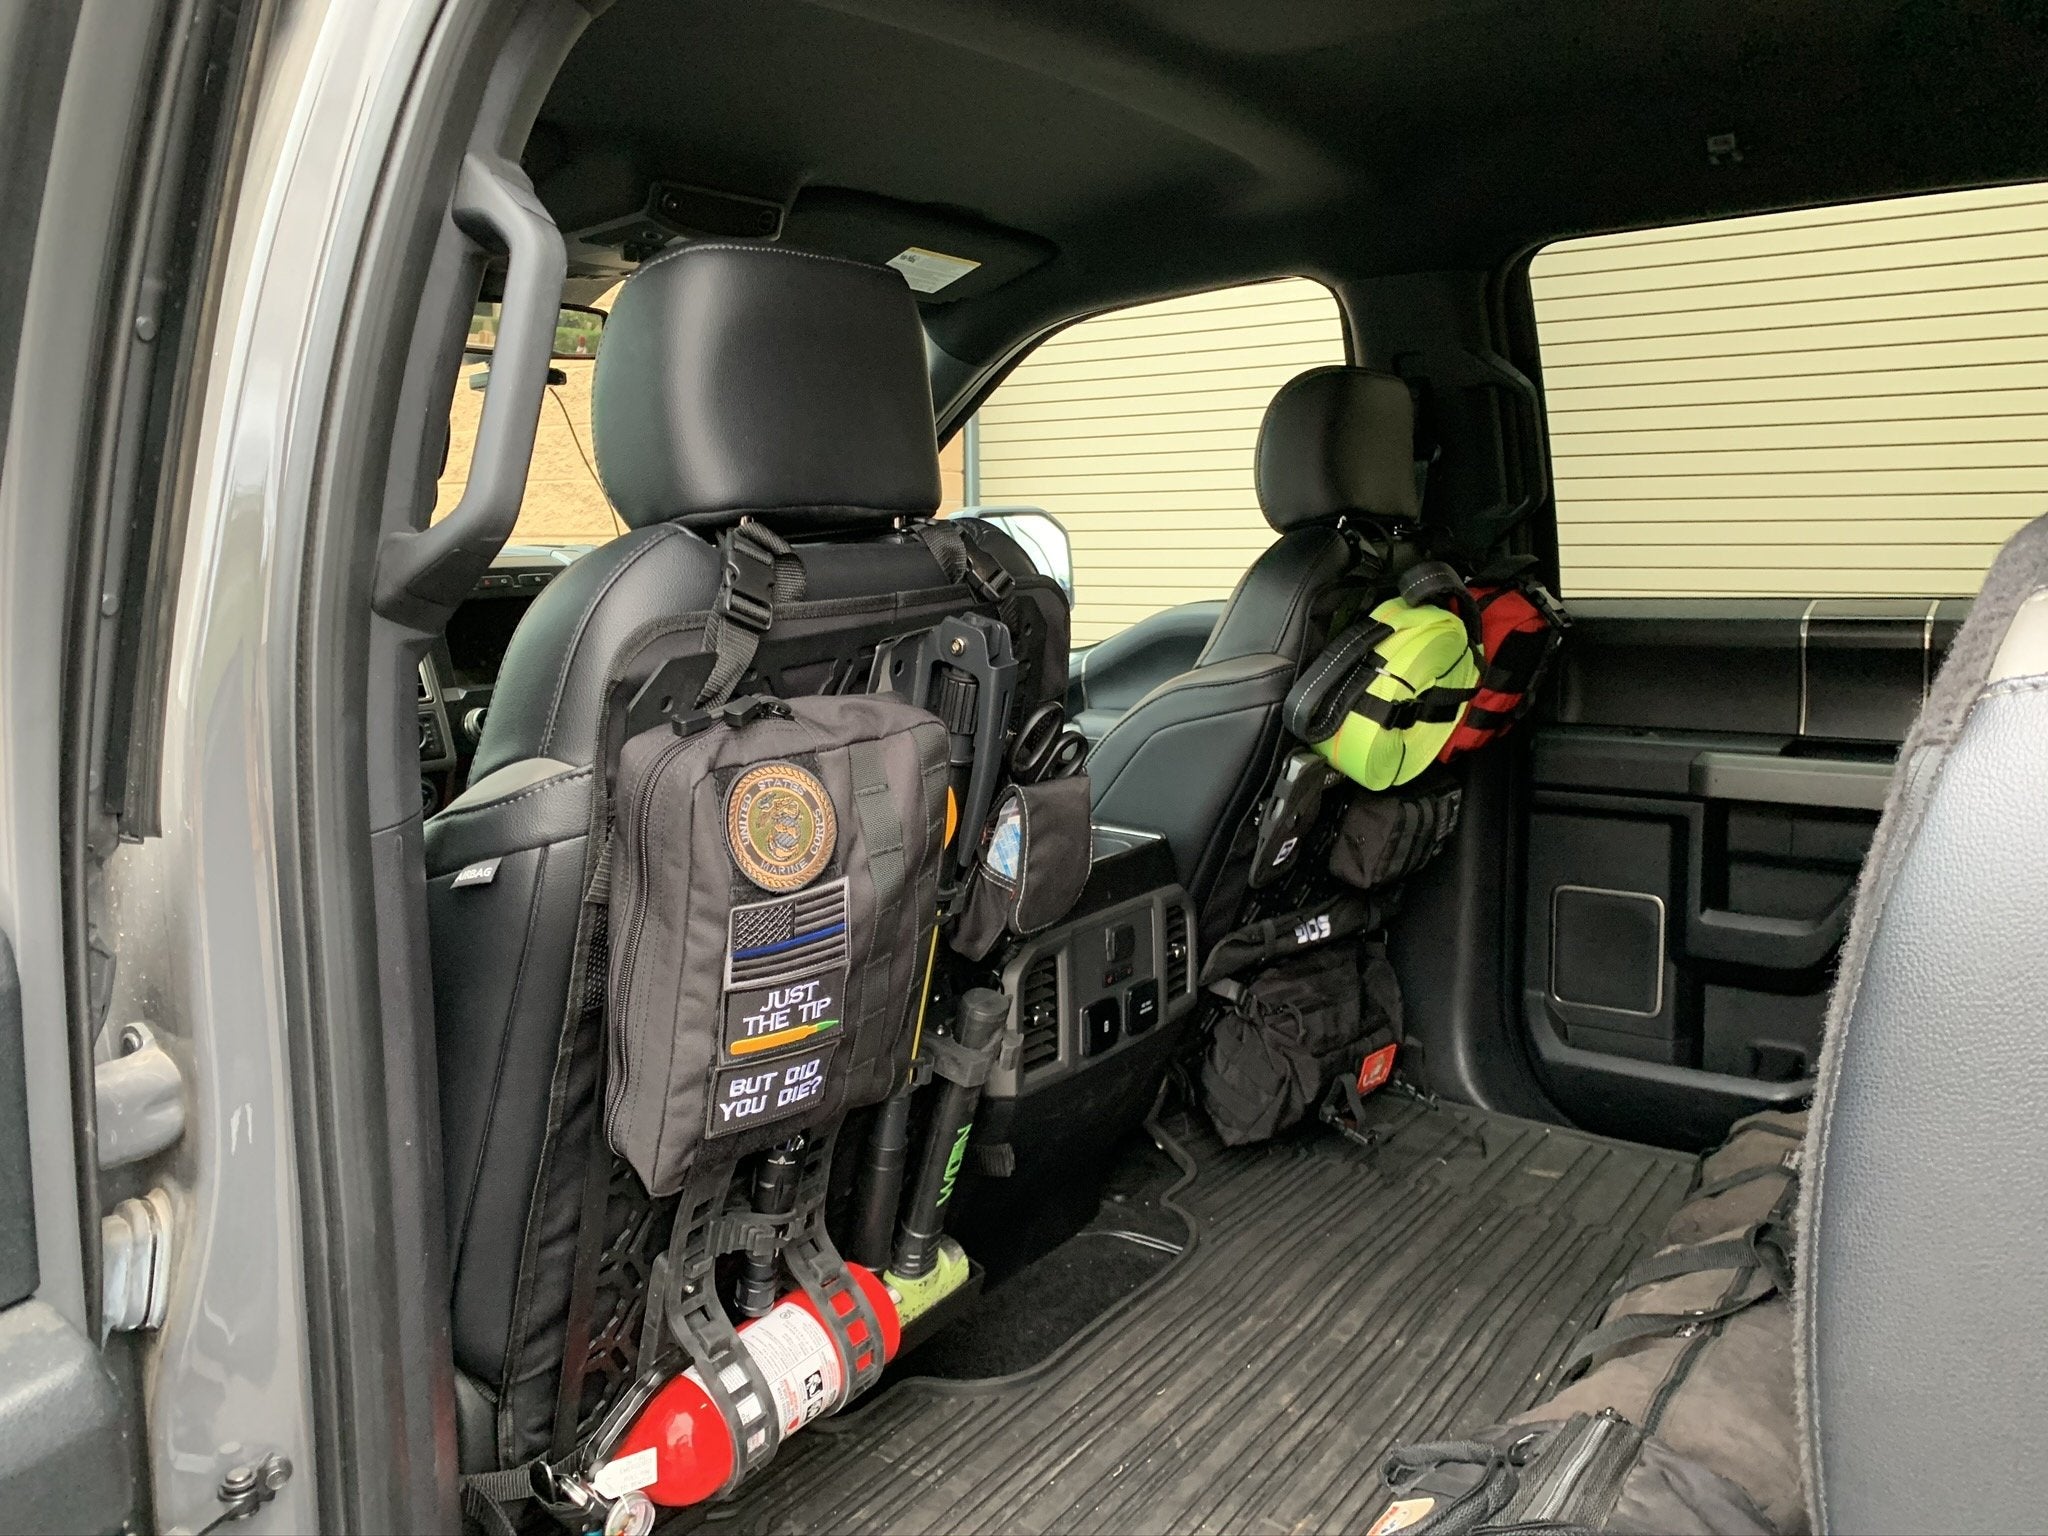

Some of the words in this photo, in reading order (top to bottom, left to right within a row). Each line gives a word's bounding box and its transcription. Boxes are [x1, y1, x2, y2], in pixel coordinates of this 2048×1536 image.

[758, 778, 807, 796] STATES
[739, 793, 752, 845] UNITED
[810, 808, 824, 855] CORPS
[455, 867, 493, 882] AIRBAG
[759, 857, 808, 875] MARINE
[760, 980, 820, 1012] JUST
[742, 1009, 791, 1036] THE
[798, 997, 832, 1023] TIP
[729, 1071, 779, 1098] BUT
[784, 1059, 820, 1086] DID
[719, 1095, 768, 1122] YOU
[777, 1075, 823, 1107] DIE?
